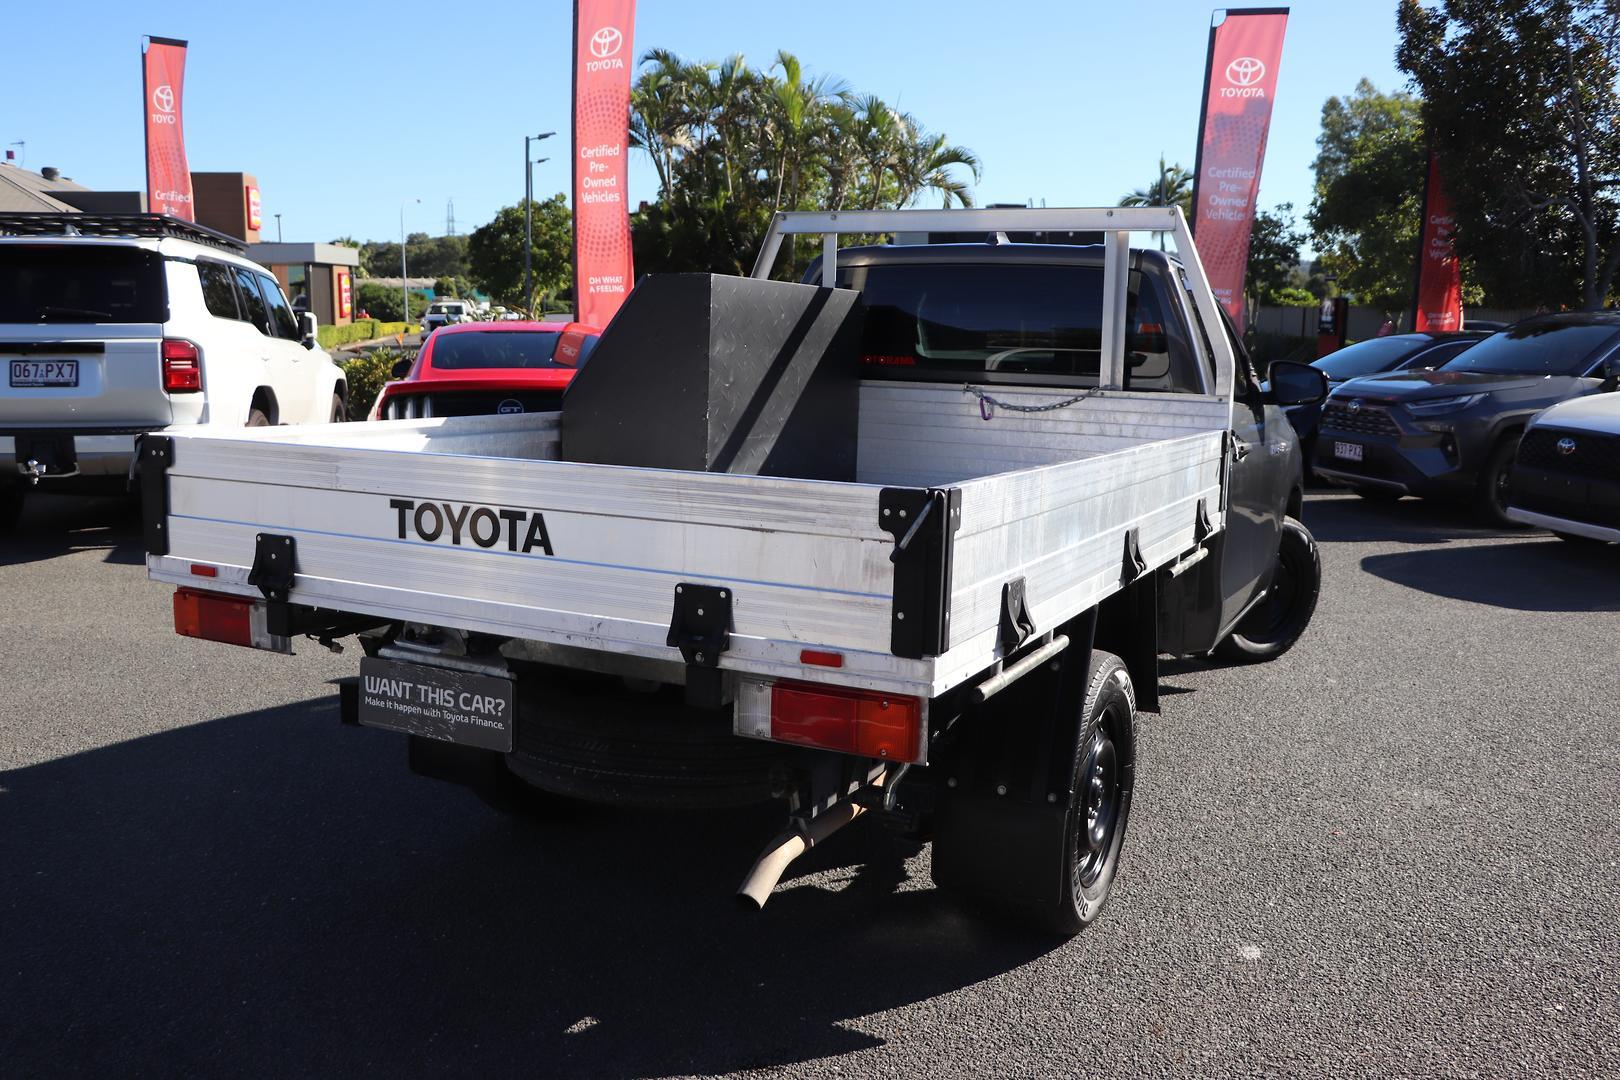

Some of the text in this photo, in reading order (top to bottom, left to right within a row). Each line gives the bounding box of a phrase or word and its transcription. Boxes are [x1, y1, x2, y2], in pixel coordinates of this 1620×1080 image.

[586, 58, 624, 72] TOYOTA
[1220, 87, 1265, 98] TOYOTA
[581, 143, 620, 159] Certified
[590, 160, 609, 173] Pre-
[1208, 166, 1256, 179] Certified
[583, 175, 617, 189] Owned
[1218, 181, 1242, 192] Pre-
[581, 189, 620, 203] Vehicles
[1209, 194, 1248, 207] Owned
[1206, 208, 1248, 220] Vehicle
[589, 275, 623, 285] OH WHAT
[589, 284, 625, 293] A FEELING
[389, 498, 554, 556] TOYOTA
[364, 675, 506, 717] WANT THIS CAR?
[364, 695, 505, 730] Make it happen with Toyota Finance.
